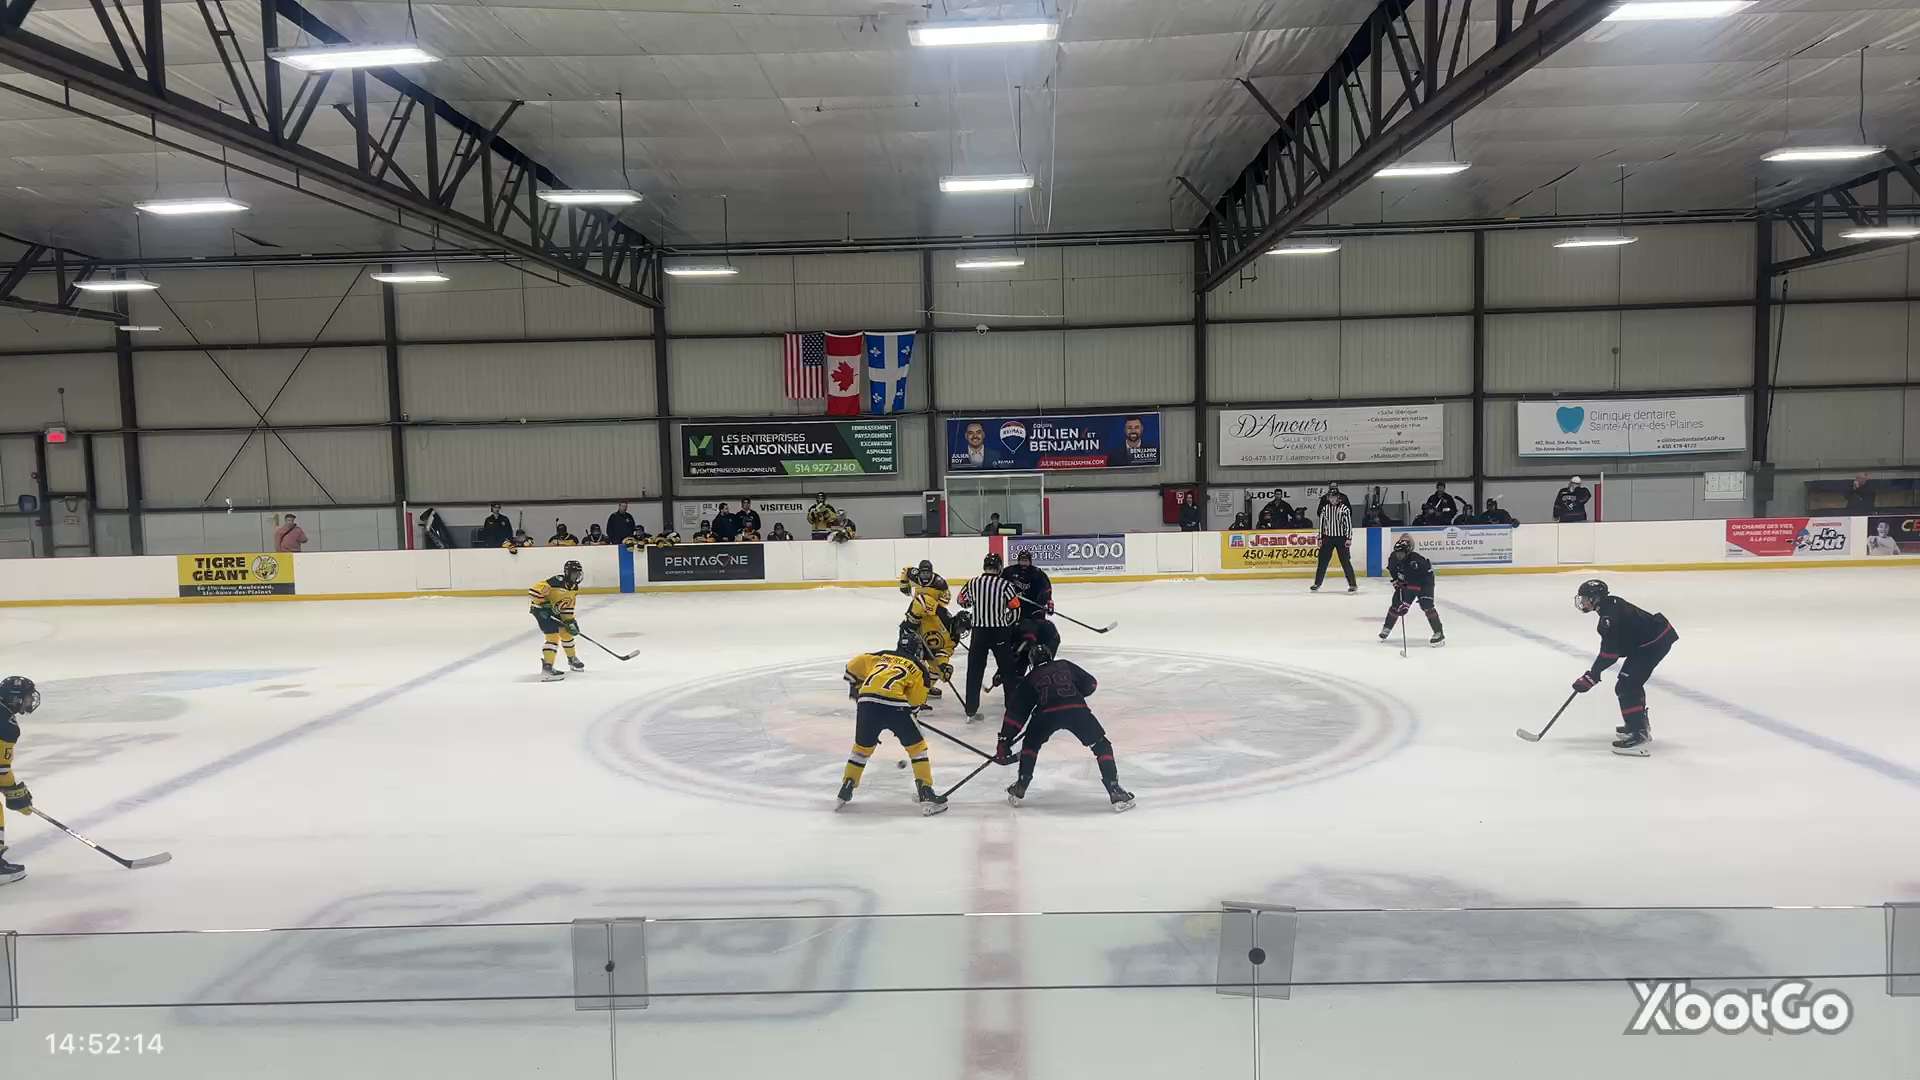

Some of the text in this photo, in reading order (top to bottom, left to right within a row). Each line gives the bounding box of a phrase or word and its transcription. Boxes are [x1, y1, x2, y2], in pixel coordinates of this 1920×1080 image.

[1590, 410, 1676, 422] Clinique dentaire
[1229, 413, 1328, 438] D'Amours
[1590, 420, 1704, 431] Sainte-Anne-des-Plaines
[721, 433, 805, 443] LES ENTREPRISES
[1030, 428, 1079, 440] JULIEN
[721, 443, 833, 456] S.MAISONNEUVE
[1030, 440, 1099, 452] BENJAMIN
[795, 464, 810, 472] 514
[1251, 491, 1291, 499] LOCL
[760, 503, 803, 512] VISITEUR
[1250, 534, 1319, 546] Jean Cou
[1810, 534, 1846, 551] but
[1010, 543, 1061, 551] LOCATION
[1067, 542, 1124, 559] 2000
[1012, 551, 1061, 560] DUTILS
[1243, 548, 1320, 559] 450-478-2040
[194, 557, 246, 569] TIGRE
[665, 554, 748, 567] PENTAGONE
[192, 568, 249, 581] GÉANT
[863, 664, 908, 690] 77
